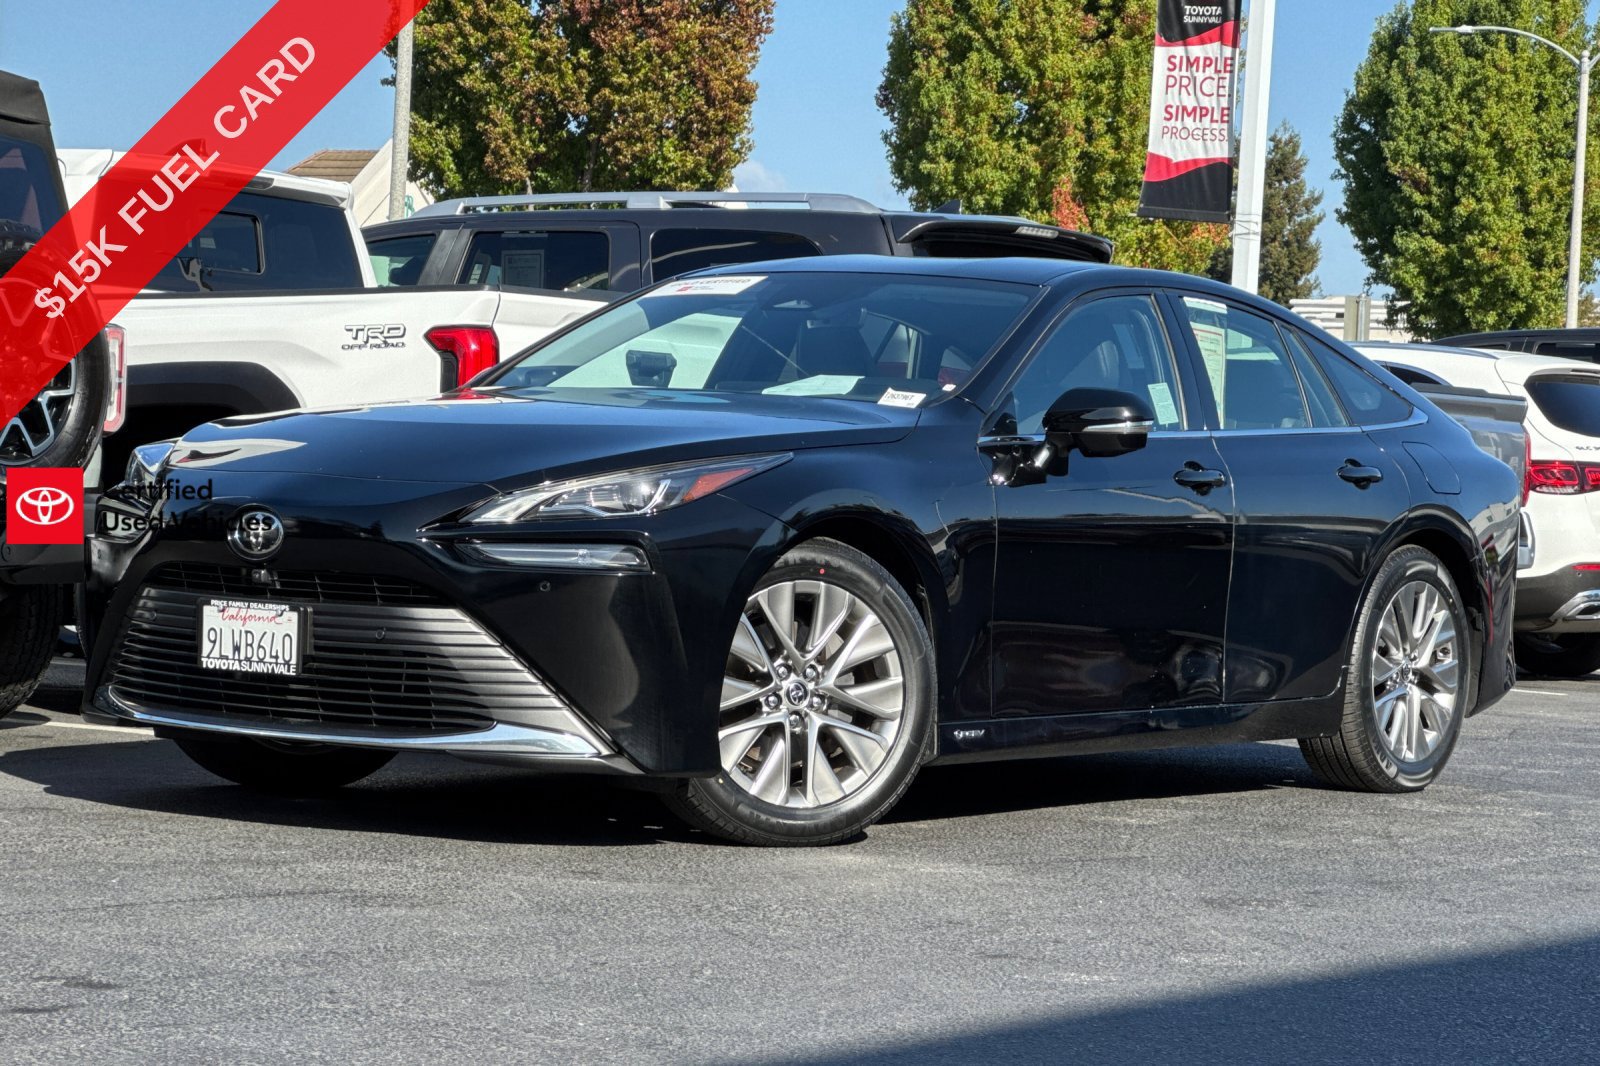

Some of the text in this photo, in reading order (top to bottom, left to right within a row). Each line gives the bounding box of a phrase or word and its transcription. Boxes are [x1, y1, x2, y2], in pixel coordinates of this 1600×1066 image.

[1184, 5, 1222, 15] TOYOTA
[1166, 55, 1234, 74] SIMPLE
[1165, 75, 1231, 98] PRICE.
[1163, 104, 1230, 124] SIMPLE
[1161, 125, 1229, 142] PROCESS.
[344, 323, 406, 344] TRD
[249, 602, 290, 611] DEALERSHIPS
[221, 607, 282, 627] California
[207, 627, 293, 664] 9LWB640
[201, 658, 297, 676] TOYOTA SUNNYVALE
